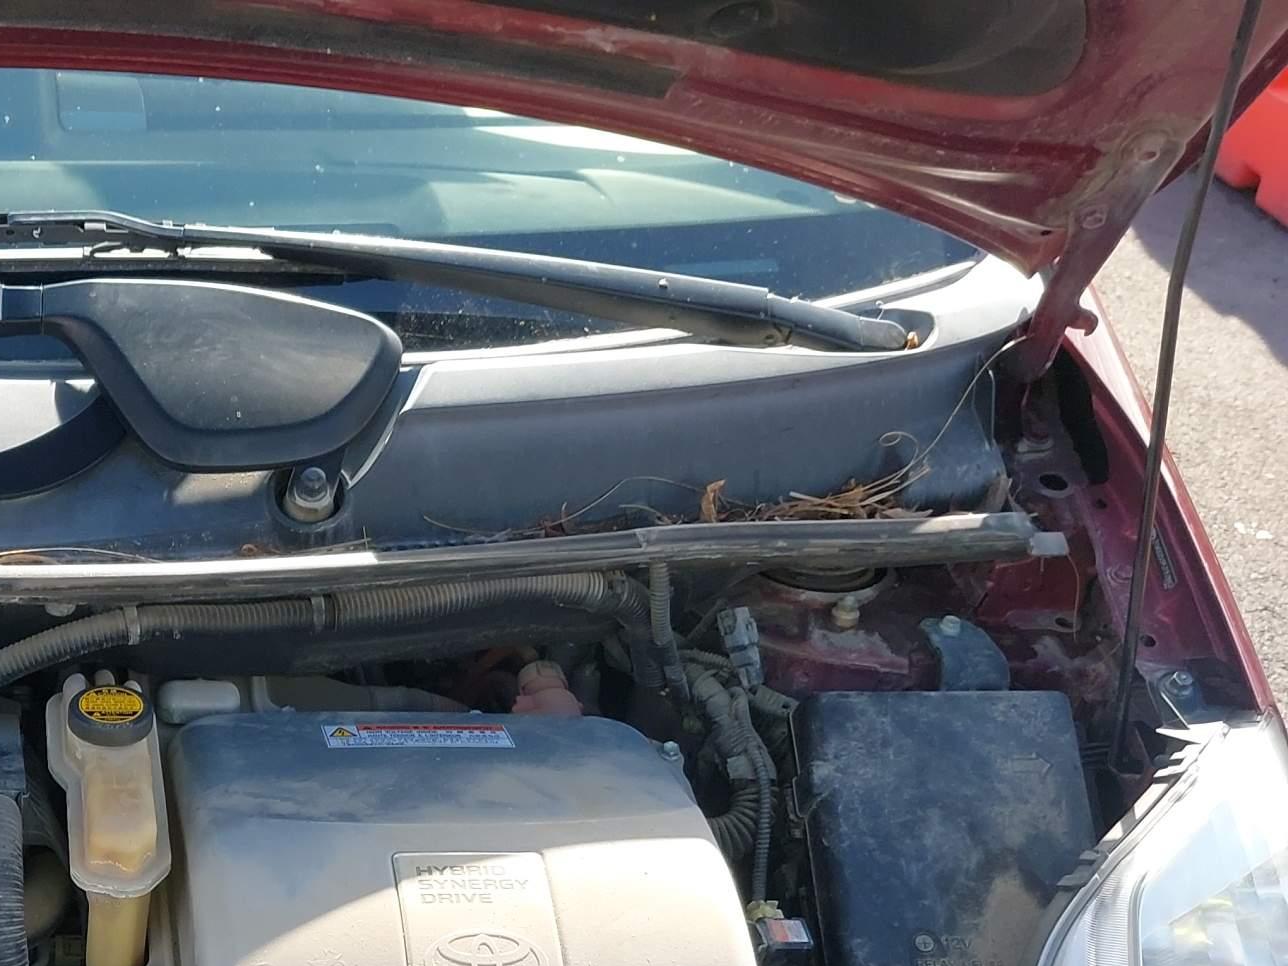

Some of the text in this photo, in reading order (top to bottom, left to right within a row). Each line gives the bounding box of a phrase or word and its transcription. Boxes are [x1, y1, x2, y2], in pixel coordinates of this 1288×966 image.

[415, 865, 505, 877] HYBRID
[417, 879, 529, 890] SYNERGY
[420, 893, 494, 904] DRIVE
